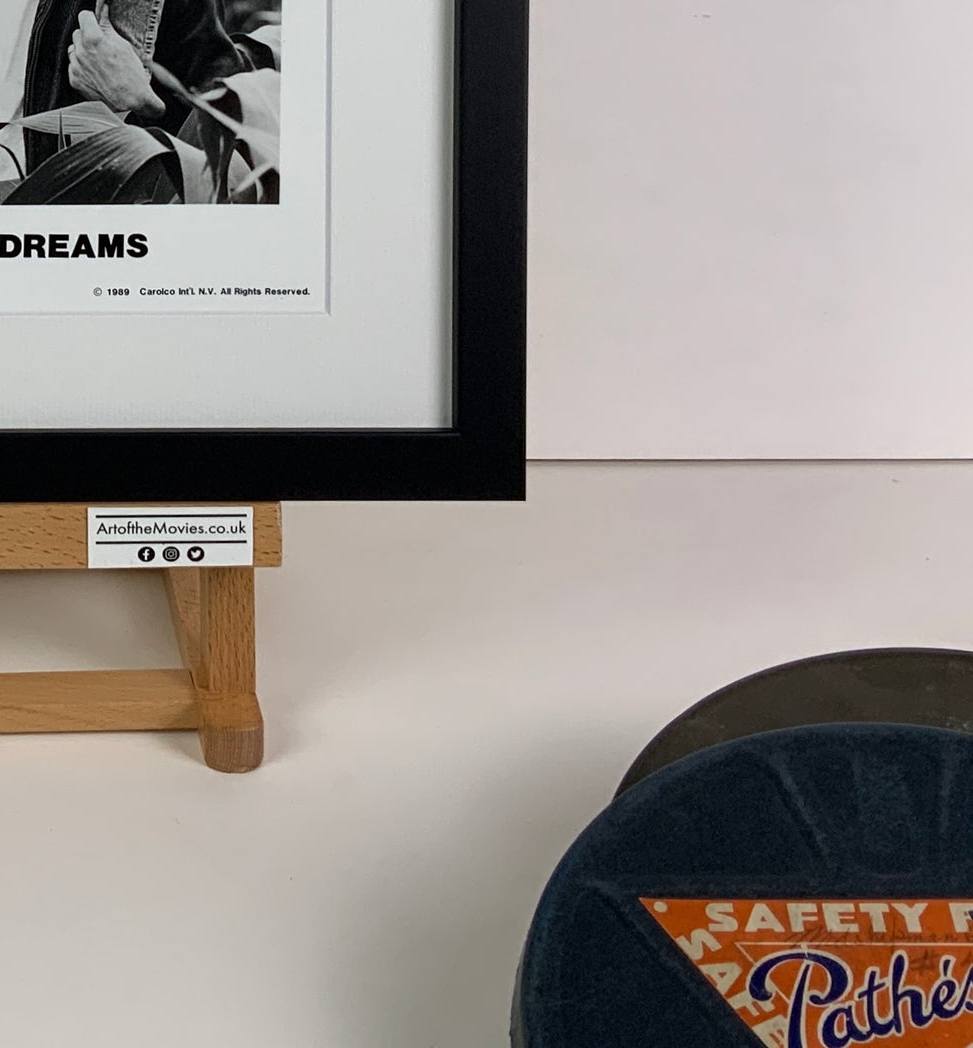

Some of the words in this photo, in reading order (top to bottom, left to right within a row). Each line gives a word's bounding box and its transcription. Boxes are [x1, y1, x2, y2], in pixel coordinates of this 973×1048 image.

[107, 288, 130, 296] 1989
[139, 287, 176, 296] Carolco
[198, 287, 217, 296] N.V.
[220, 287, 232, 296] All
[234, 287, 262, 297] Rights
[264, 287, 311, 296] Reserved.
[96, 520, 247, 535] ArtoftheMovies.co.uk
[705, 902, 929, 933] SAFETY
